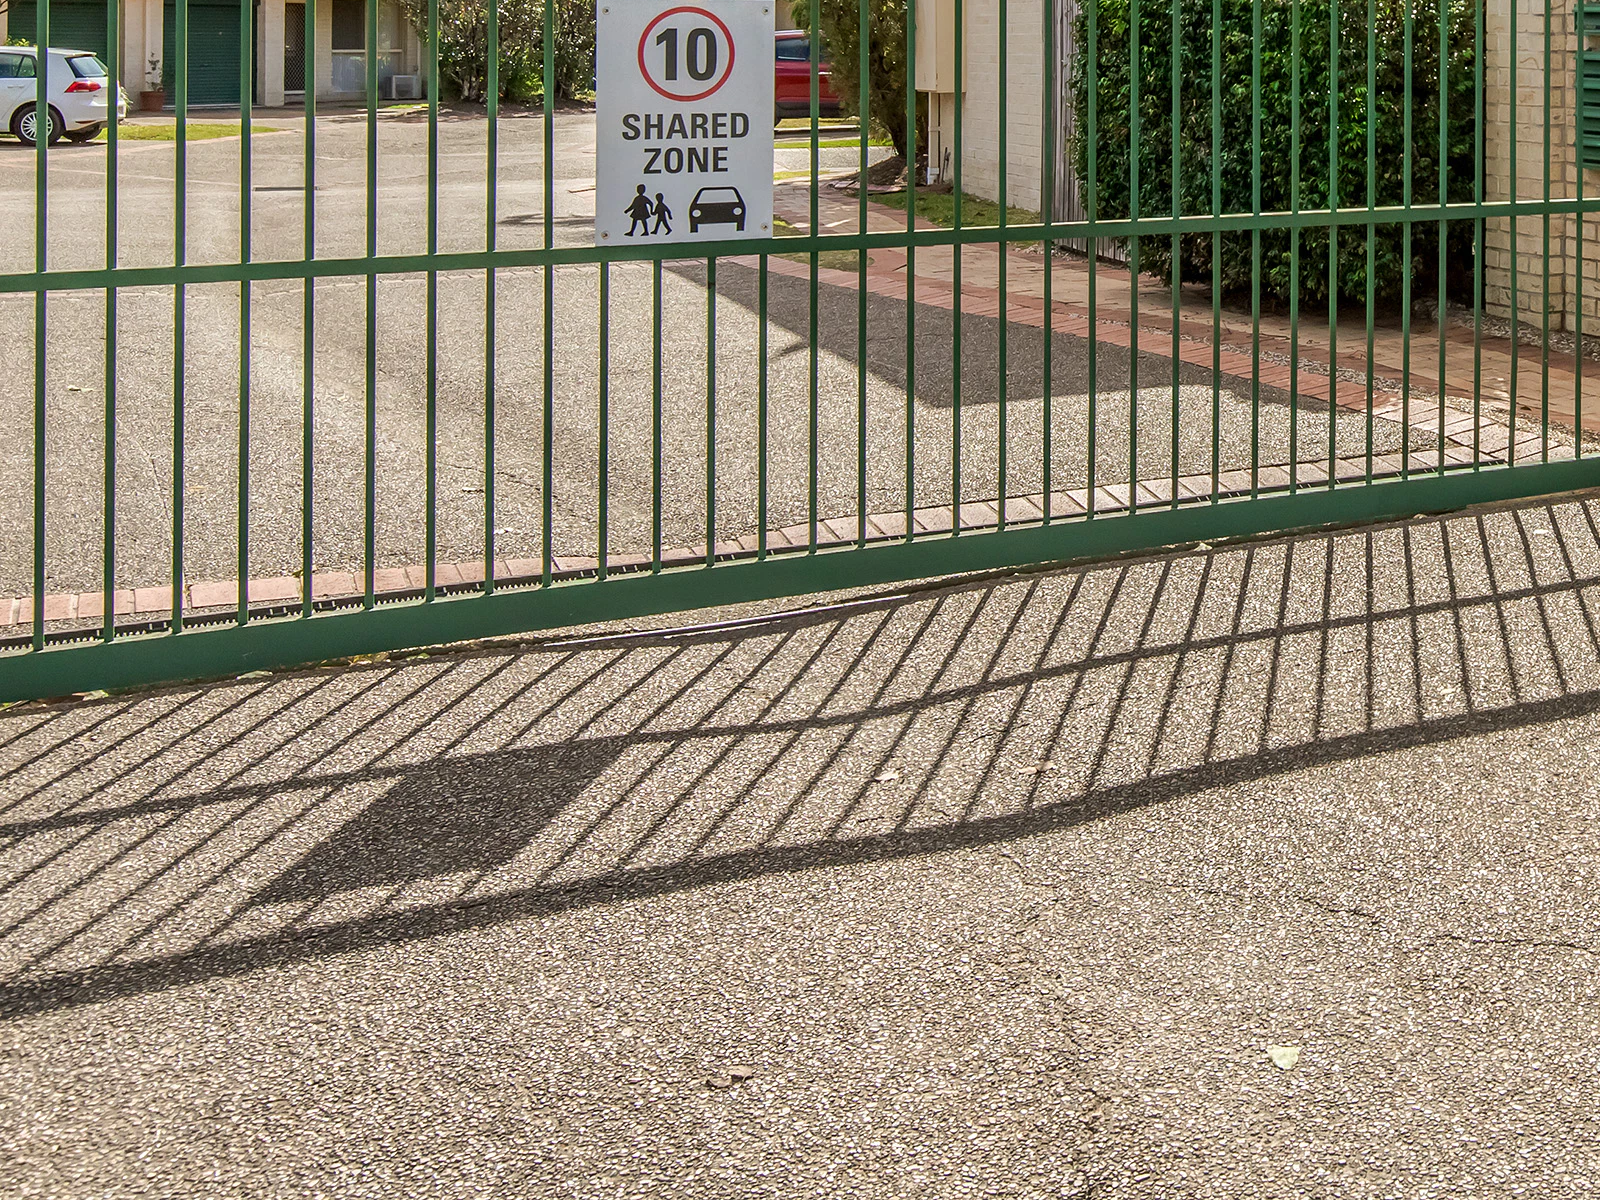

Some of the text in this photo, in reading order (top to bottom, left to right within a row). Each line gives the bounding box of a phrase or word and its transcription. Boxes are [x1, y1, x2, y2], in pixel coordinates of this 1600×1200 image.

[655, 27, 718, 81] 10
[621, 112, 749, 141] SHARED
[643, 146, 728, 175] ZONE
